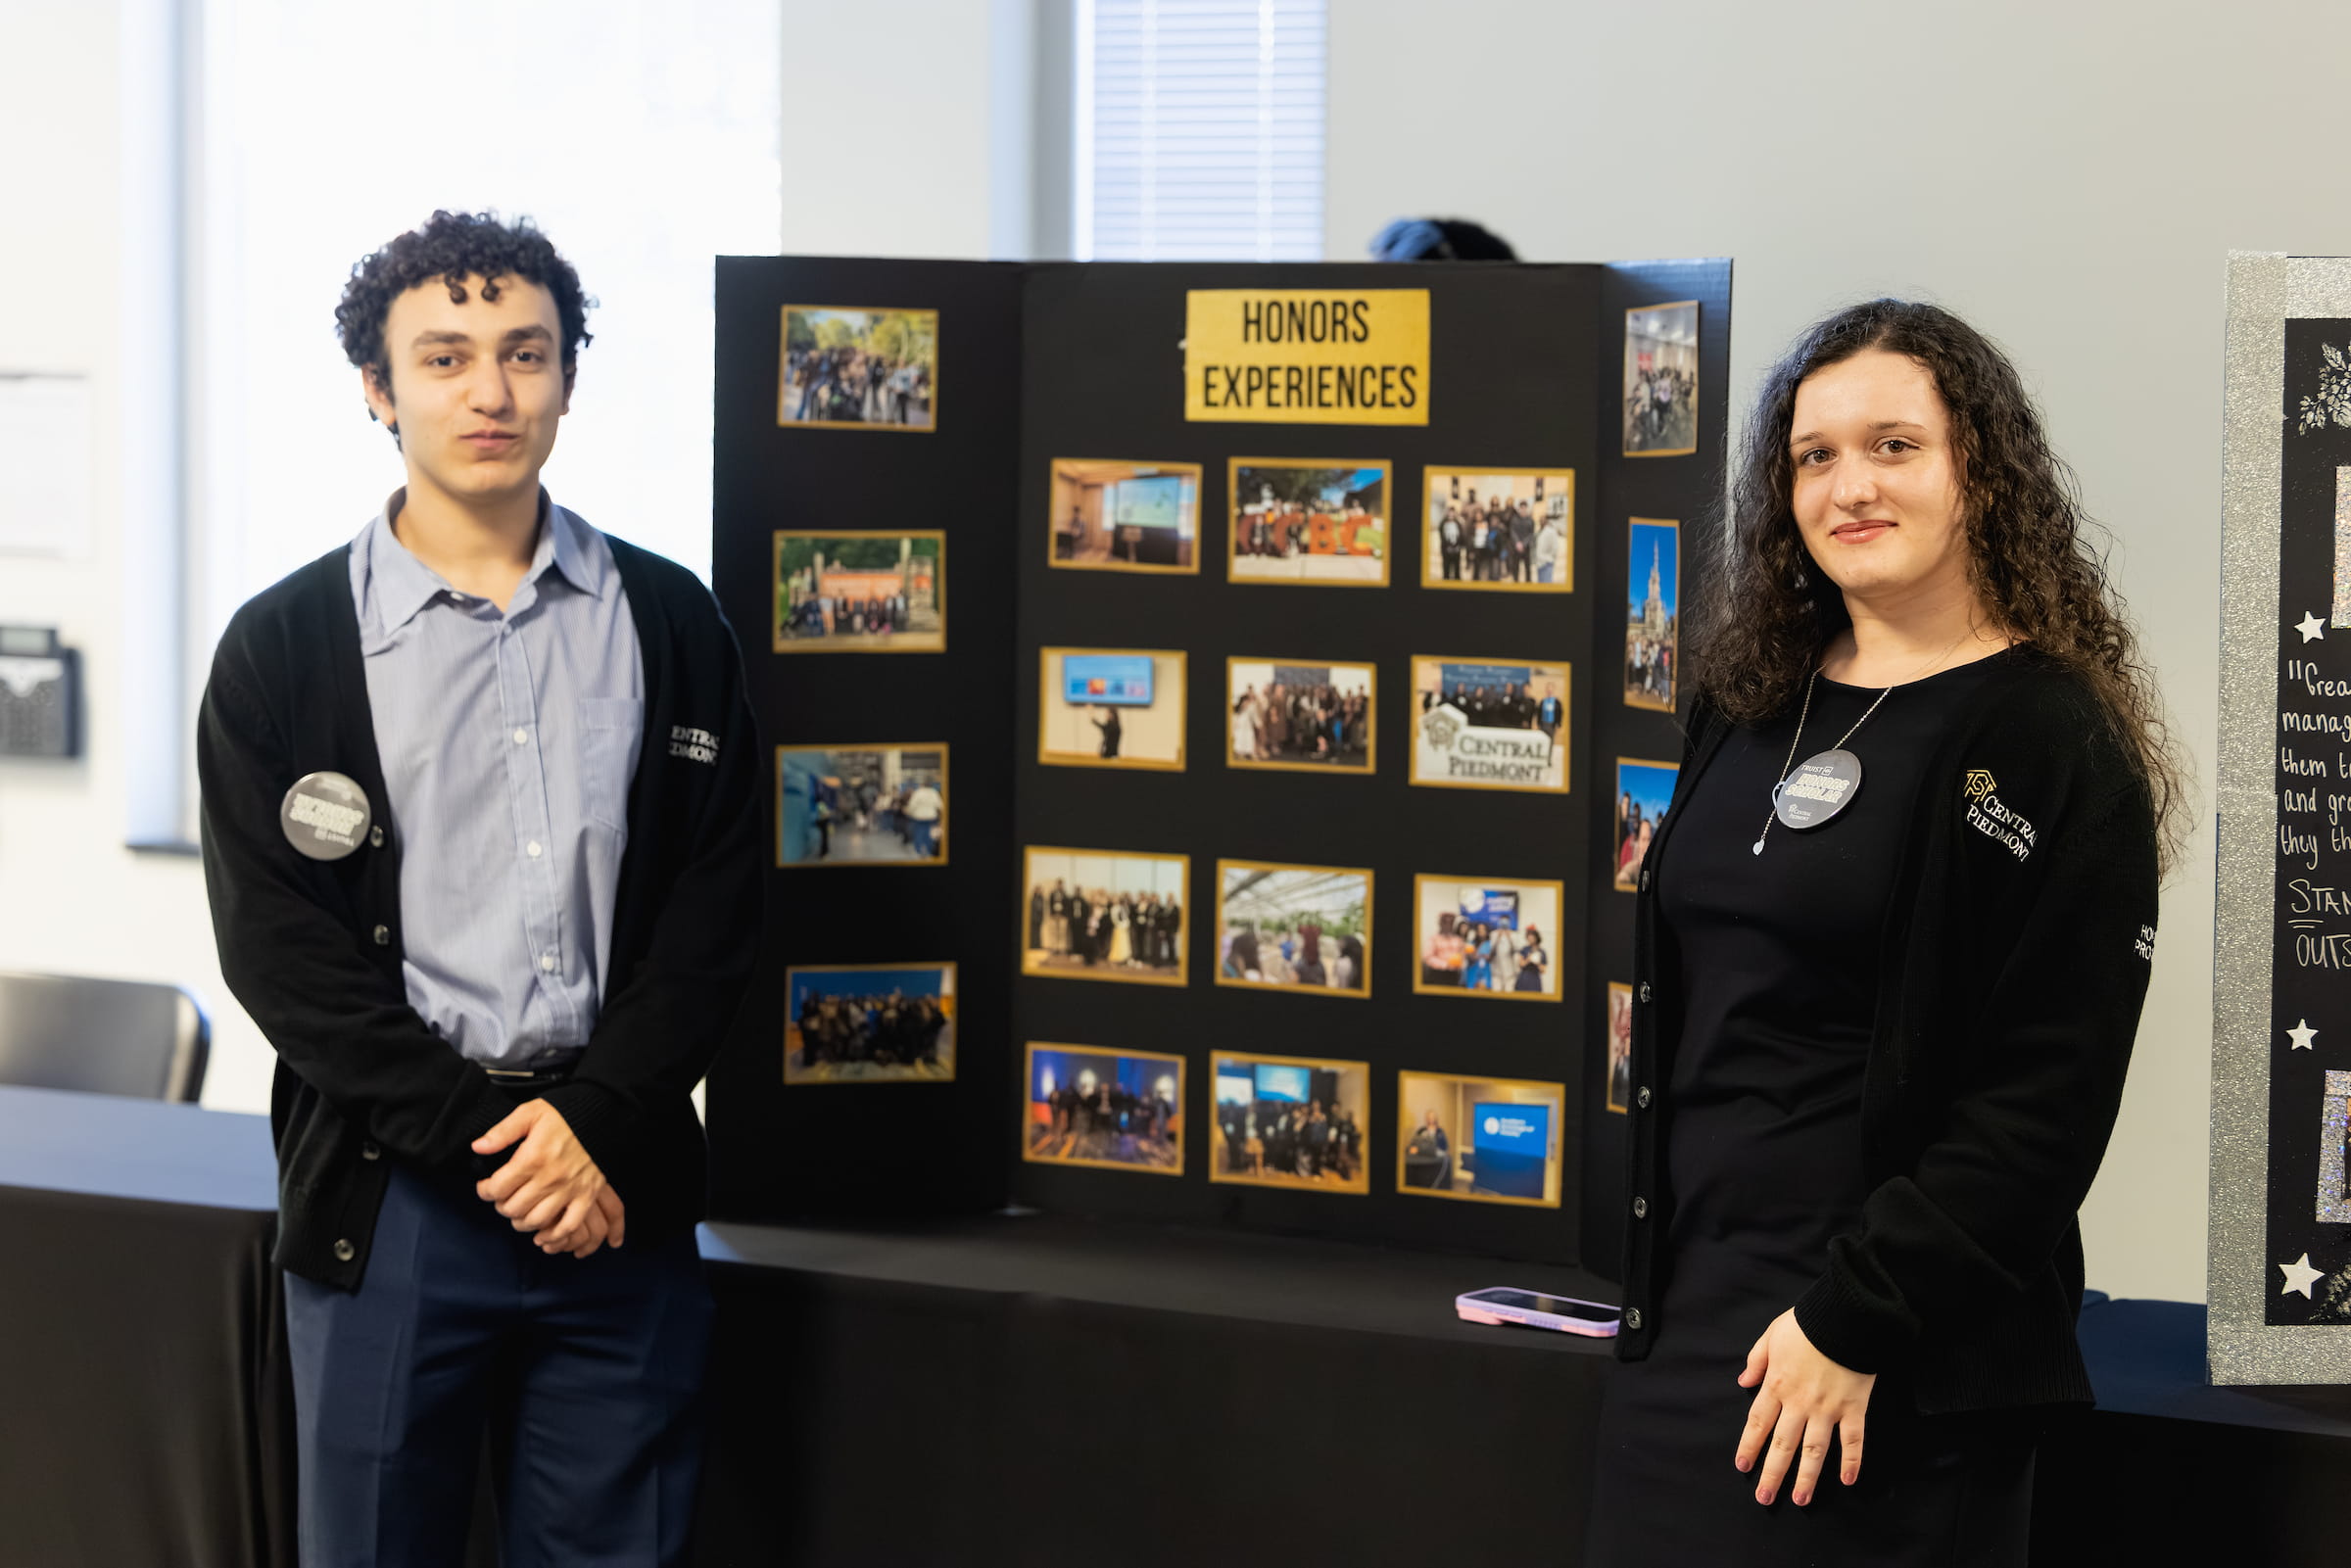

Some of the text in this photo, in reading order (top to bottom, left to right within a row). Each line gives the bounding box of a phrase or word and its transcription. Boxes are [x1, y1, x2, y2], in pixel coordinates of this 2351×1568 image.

[1243, 300, 1369, 344] HONORS
[1203, 365, 1417, 408] EXPERIENCES
[1459, 736, 1546, 760] CENTRAL
[1448, 755, 1544, 783] PIEDMONT
[2281, 746, 2351, 779] them t
[1785, 784, 1843, 803] SCHOLAR
[1796, 773, 1850, 791] HONORS
[2284, 787, 2317, 813] and
[1984, 795, 2038, 848] CENTRA
[2280, 825, 2319, 871] they
[2140, 924, 2155, 941] HO
[2134, 939, 2154, 960] PRO
